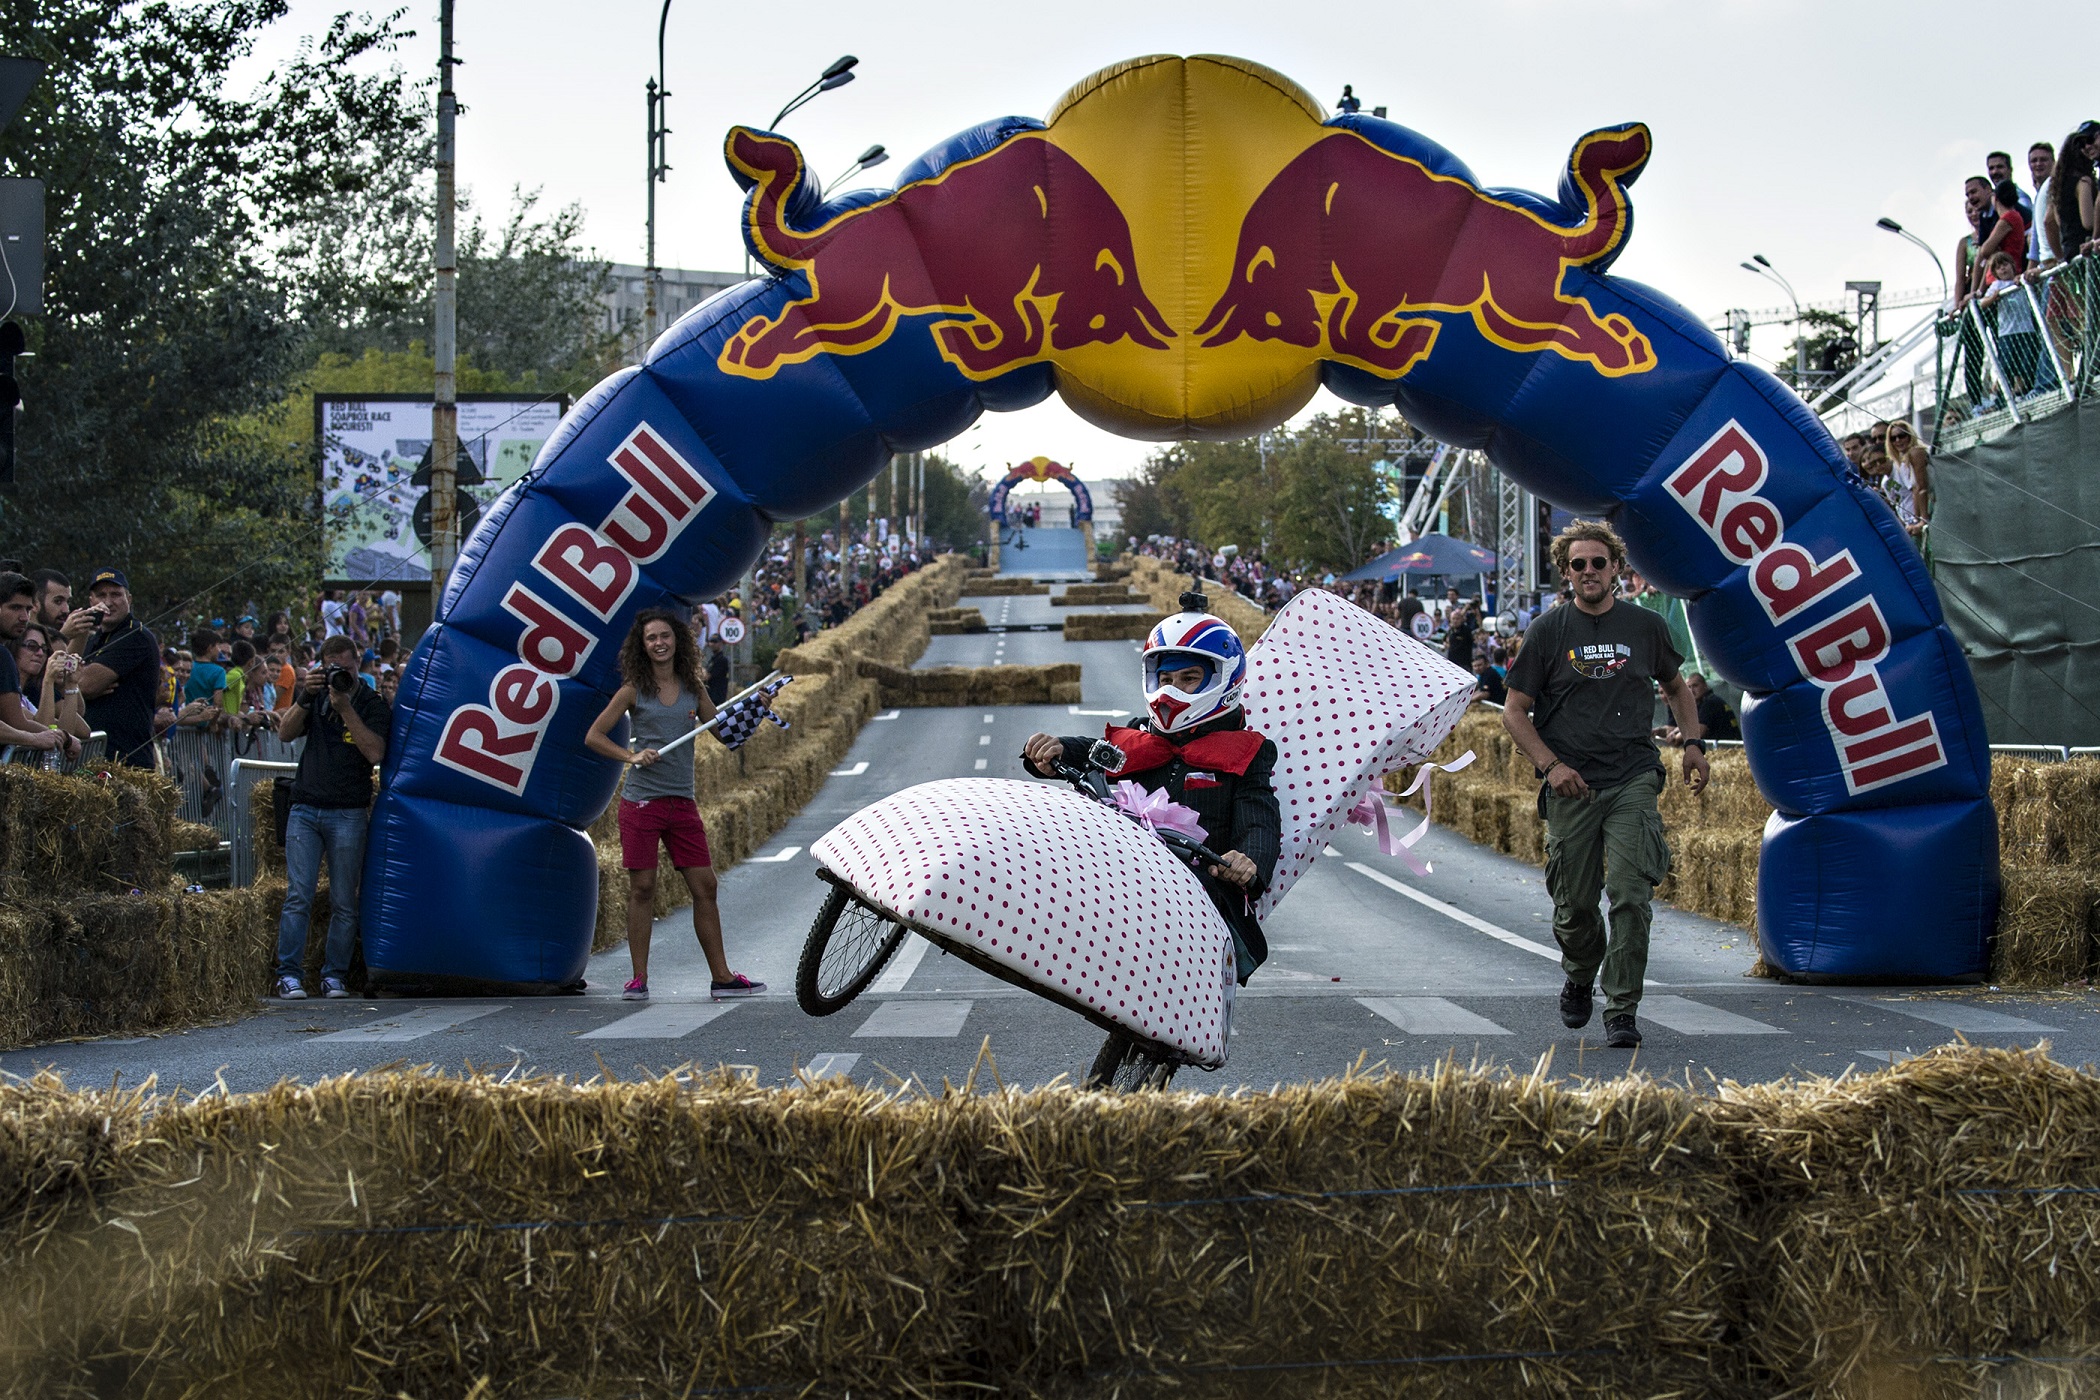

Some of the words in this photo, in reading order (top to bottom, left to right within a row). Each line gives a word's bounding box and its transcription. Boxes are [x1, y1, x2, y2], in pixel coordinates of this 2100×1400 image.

[330, 402, 346, 411] RED
[348, 402, 366, 411] BULL
[330, 412, 369, 421] SOAPBOX
[371, 411, 391, 421] RACE
[433, 581, 599, 796] Red
[530, 421, 717, 624] Bull
[1662, 418, 1862, 627] Red
[1785, 594, 1948, 796] Bull
[725, 627, 740, 638] 100
[1583, 646, 1597, 654] RED
[1598, 645, 1614, 653] BULL
